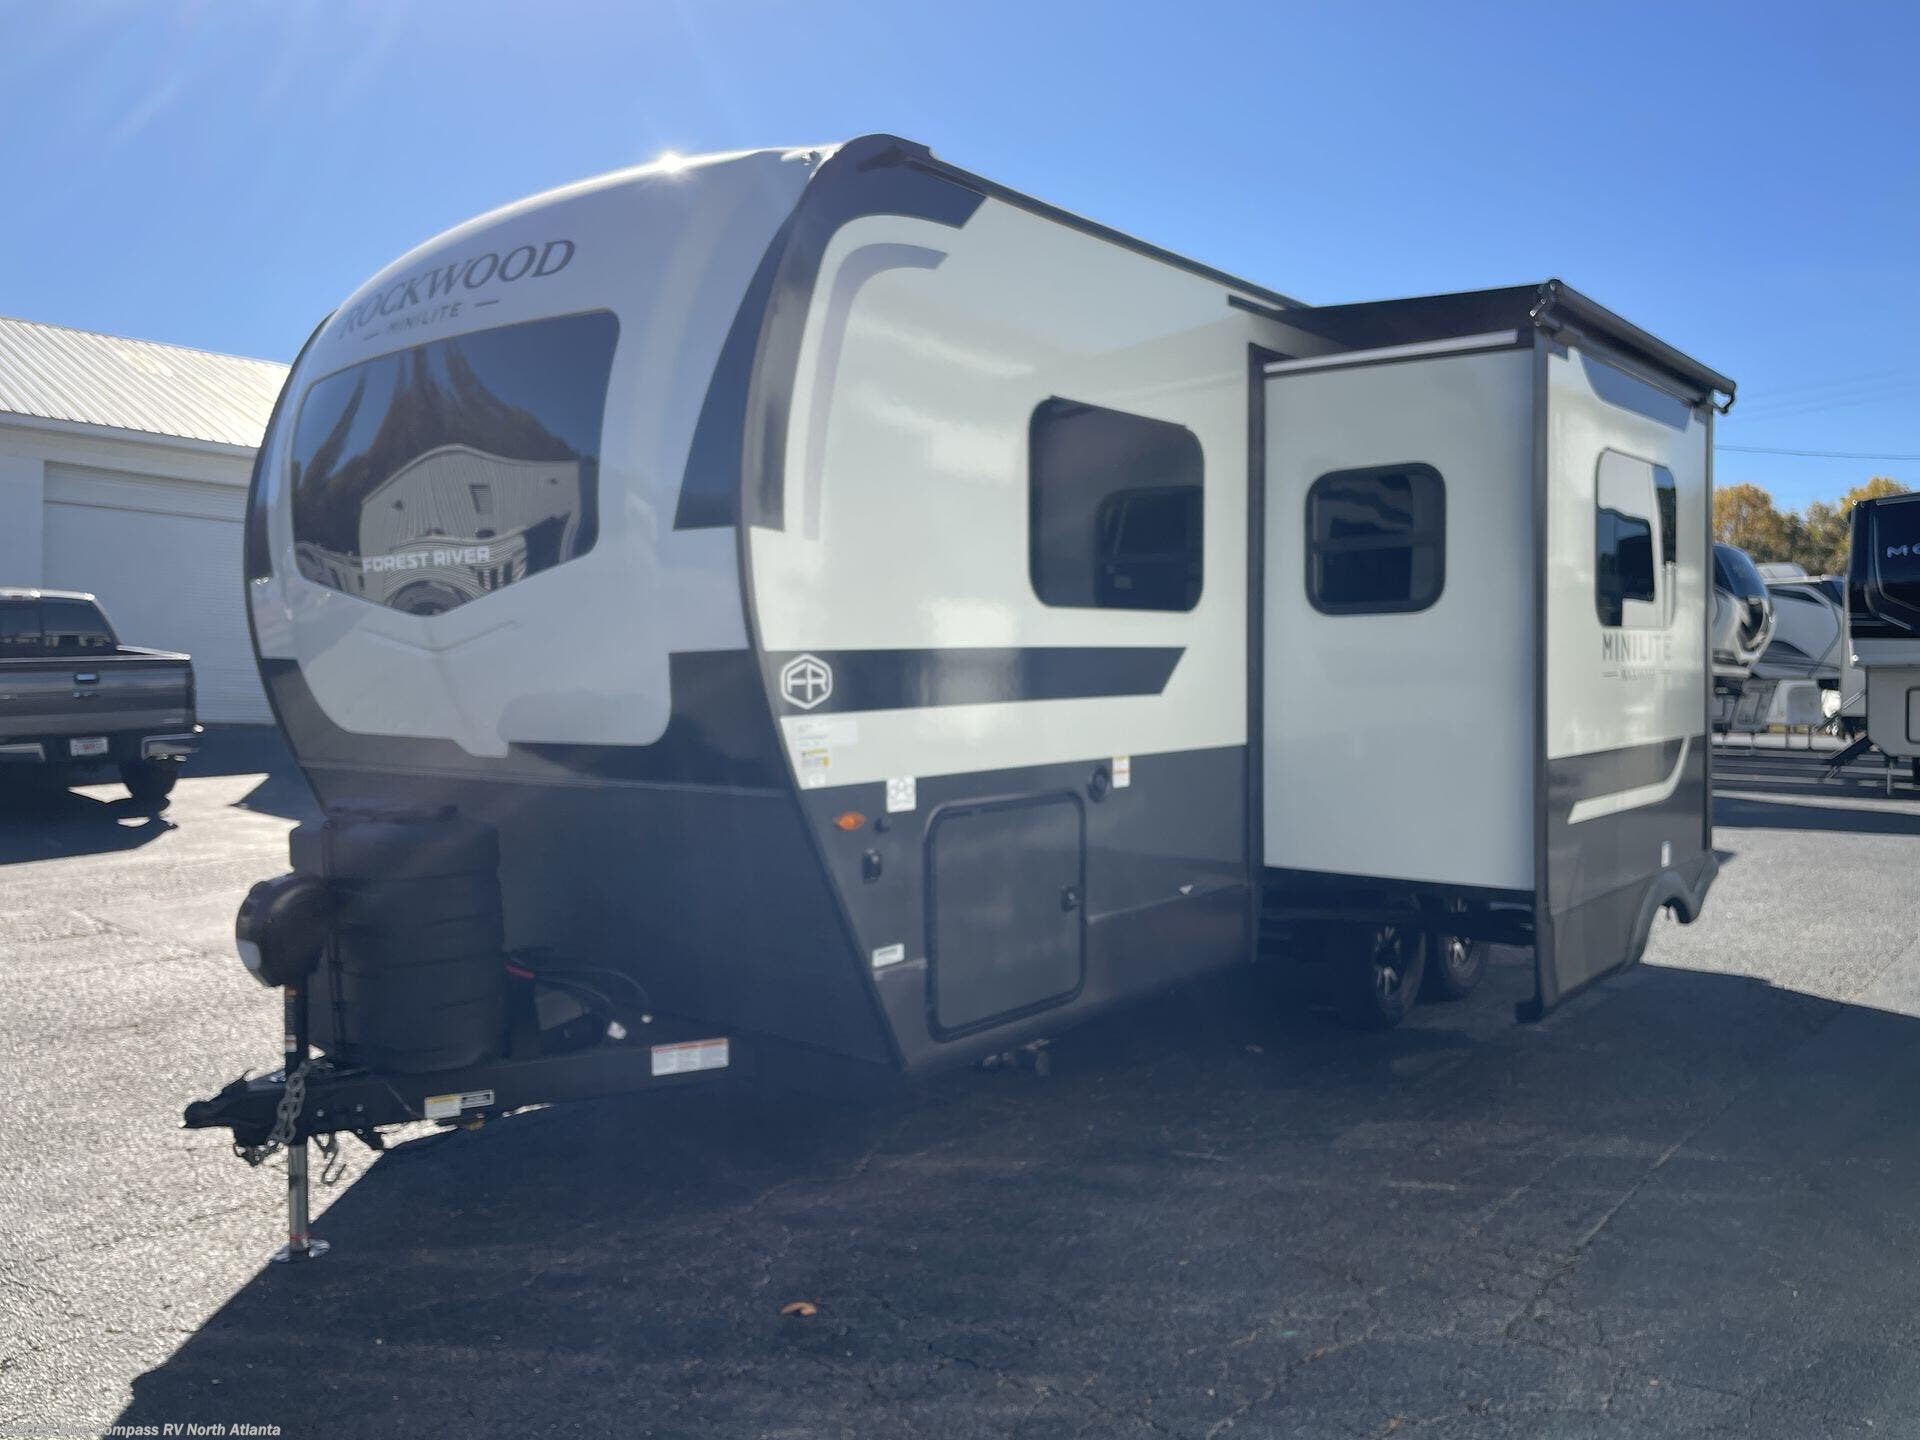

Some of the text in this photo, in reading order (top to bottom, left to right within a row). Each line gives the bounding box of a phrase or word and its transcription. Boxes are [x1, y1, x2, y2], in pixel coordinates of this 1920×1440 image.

[337, 239, 576, 341] ROCKWOOD
[388, 301, 464, 336] MINILITE
[361, 545, 490, 574] FOREST RIVER
[1601, 631, 1673, 662] MINILITE
